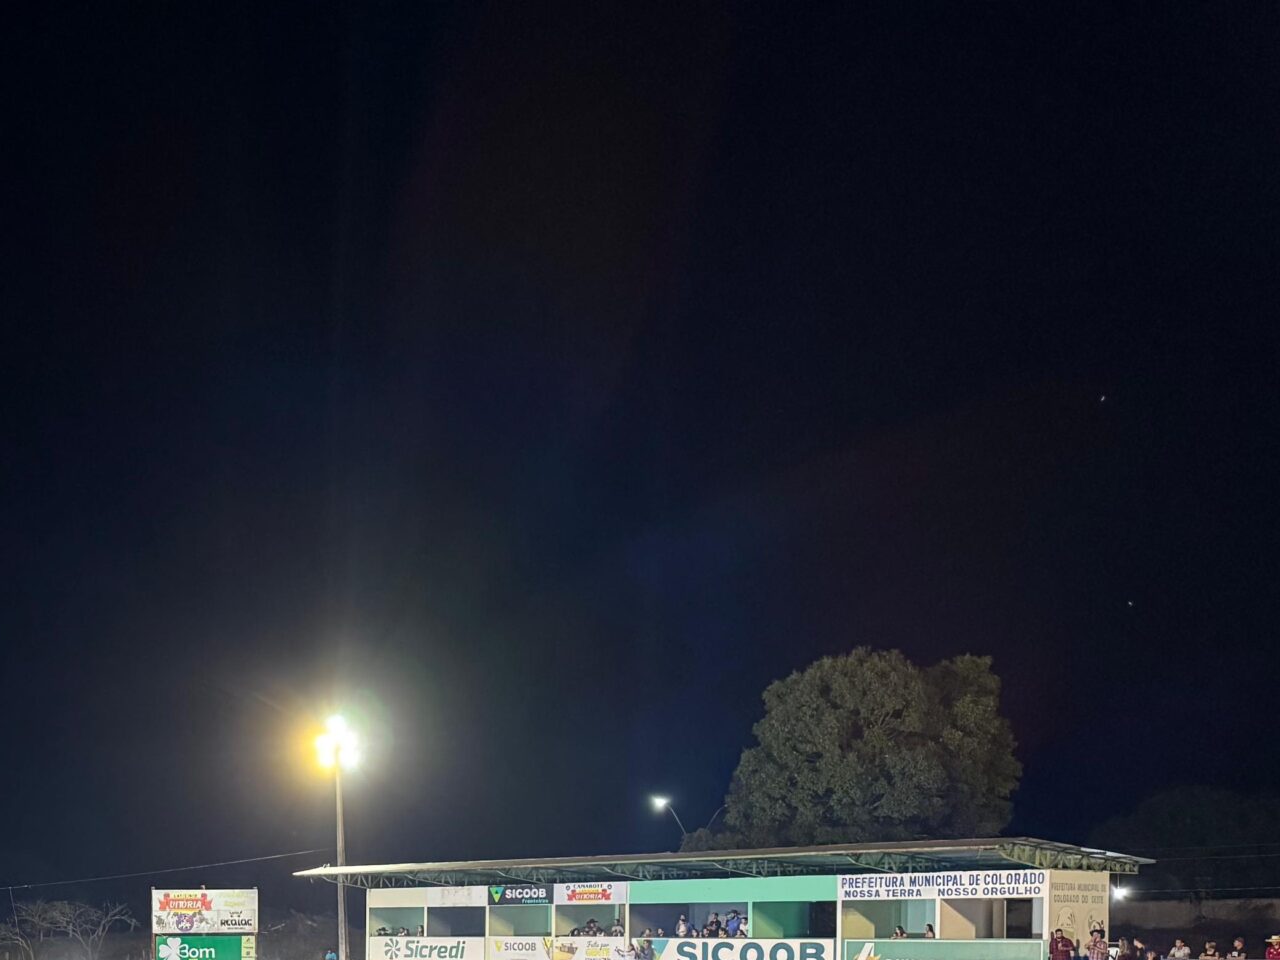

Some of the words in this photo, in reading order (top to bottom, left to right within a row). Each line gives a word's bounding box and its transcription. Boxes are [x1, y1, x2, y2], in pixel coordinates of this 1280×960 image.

[841, 876, 905, 889] PREFEITURA
[909, 874, 965, 888] MUNICIPAL
[969, 873, 981, 886] DE
[984, 872, 1045, 885] COLORADO
[505, 888, 547, 899] SICOOB
[844, 889, 880, 898] NOSSA
[885, 889, 922, 897] TERRA
[937, 887, 978, 896] NOSSO
[982, 886, 1041, 896] ORGULHO
[179, 943, 216, 959] Bom
[404, 939, 466, 959] Sicredi
[504, 942, 537, 952] SICOOB
